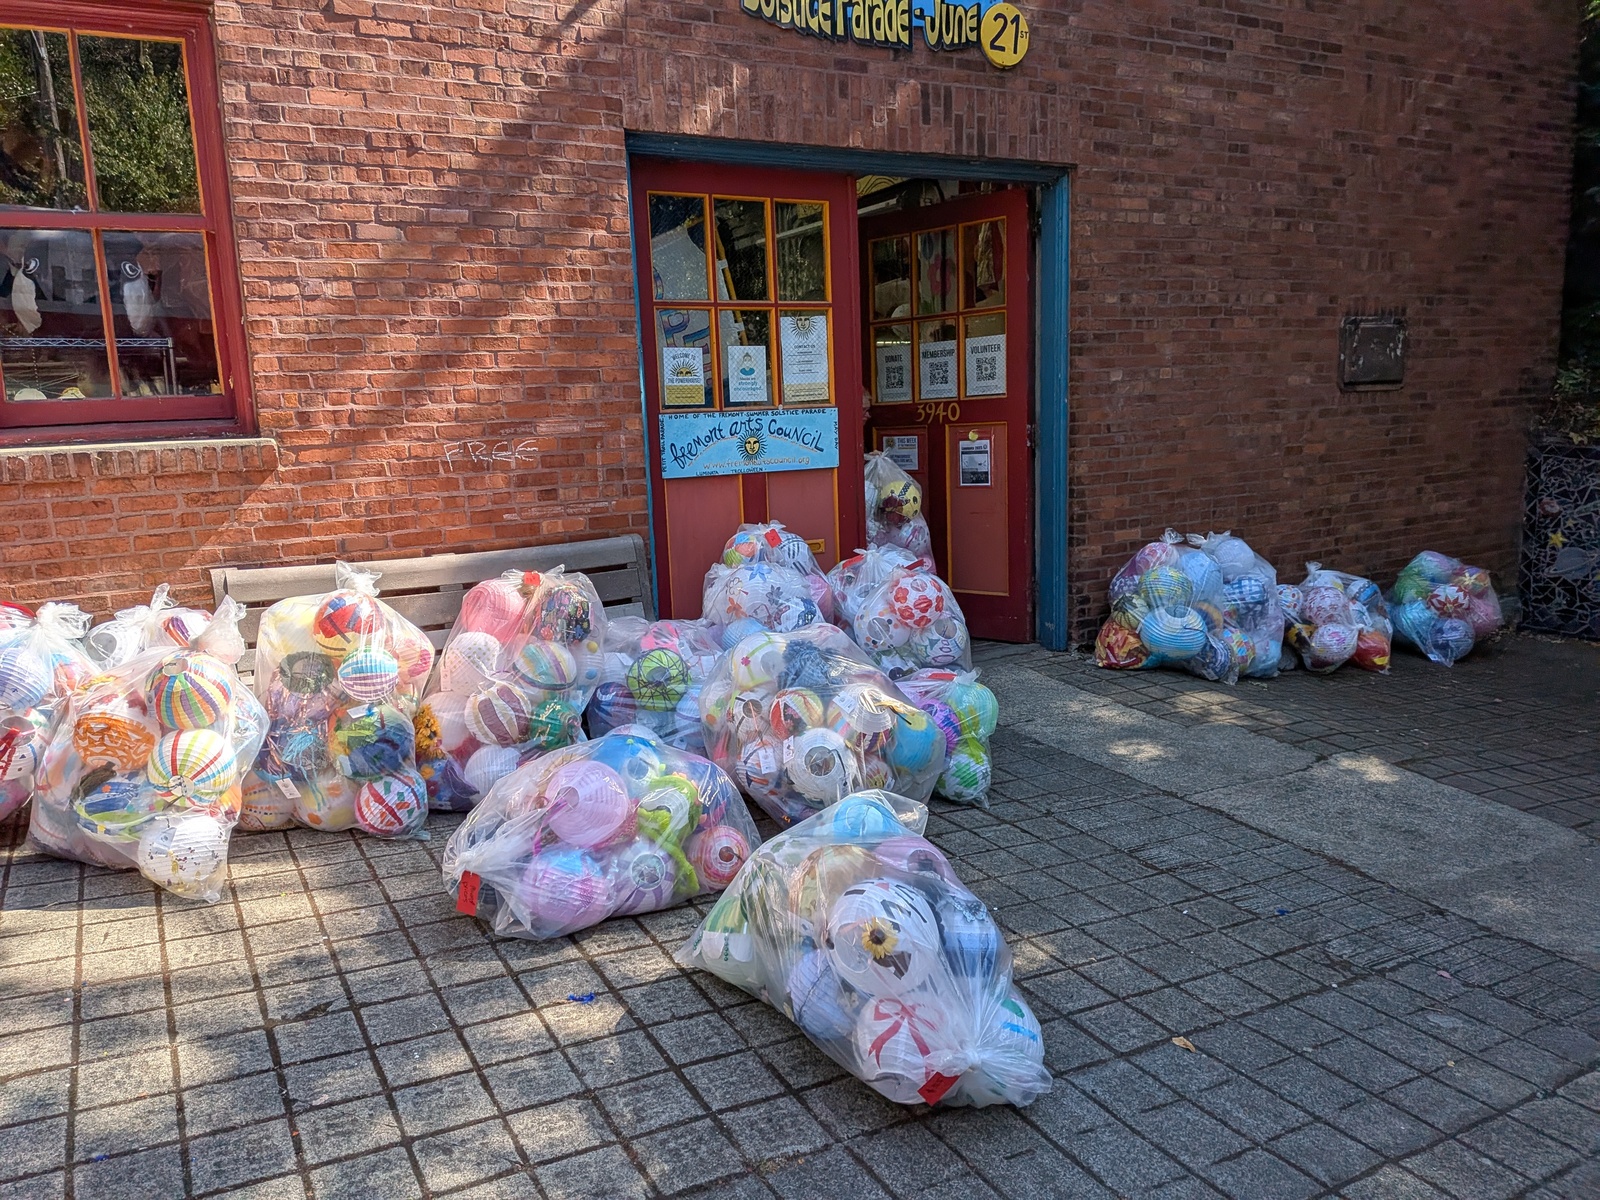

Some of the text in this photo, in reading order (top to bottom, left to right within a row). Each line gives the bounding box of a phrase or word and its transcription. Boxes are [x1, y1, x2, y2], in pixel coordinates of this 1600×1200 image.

[743, 0, 832, 36] olstice
[836, 0, 910, 46] Parade
[924, 0, 978, 46] June
[921, 349, 955, 359] MEMBERSHIP
[970, 344, 1001, 355] VOLUNTEER
[671, 352, 691, 360] WELCOME
[884, 354, 903, 363] DONATE
[770, 409, 799, 417] SOLSTICE
[915, 402, 960, 424] 3940
